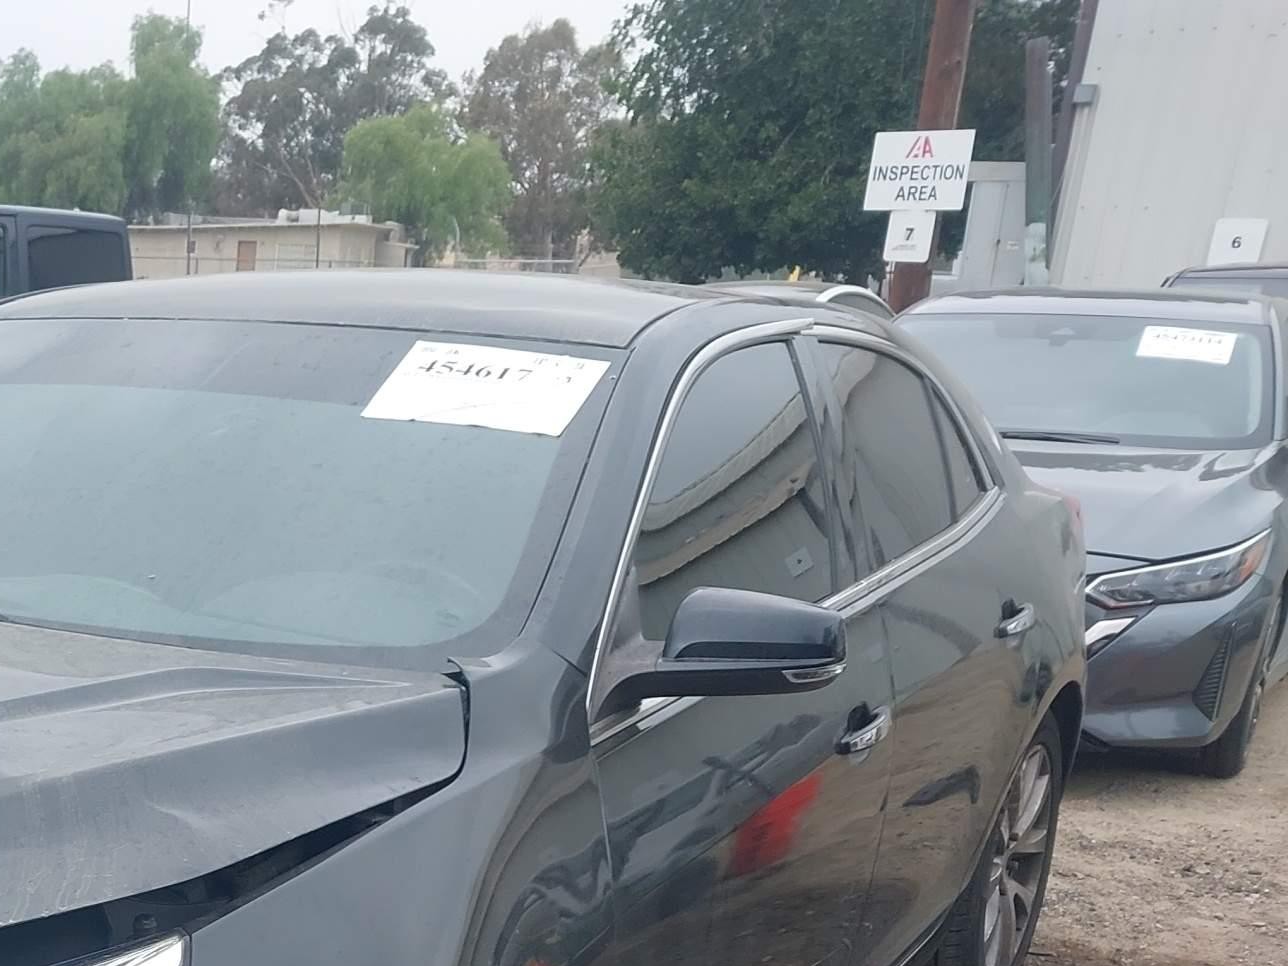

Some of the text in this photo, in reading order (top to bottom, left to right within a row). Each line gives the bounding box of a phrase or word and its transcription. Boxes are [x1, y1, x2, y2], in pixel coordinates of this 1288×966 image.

[872, 164, 965, 181] INSPECTION
[894, 185, 937, 201] AREA
[905, 227, 915, 241] 7
[1232, 236, 1242, 249] 6
